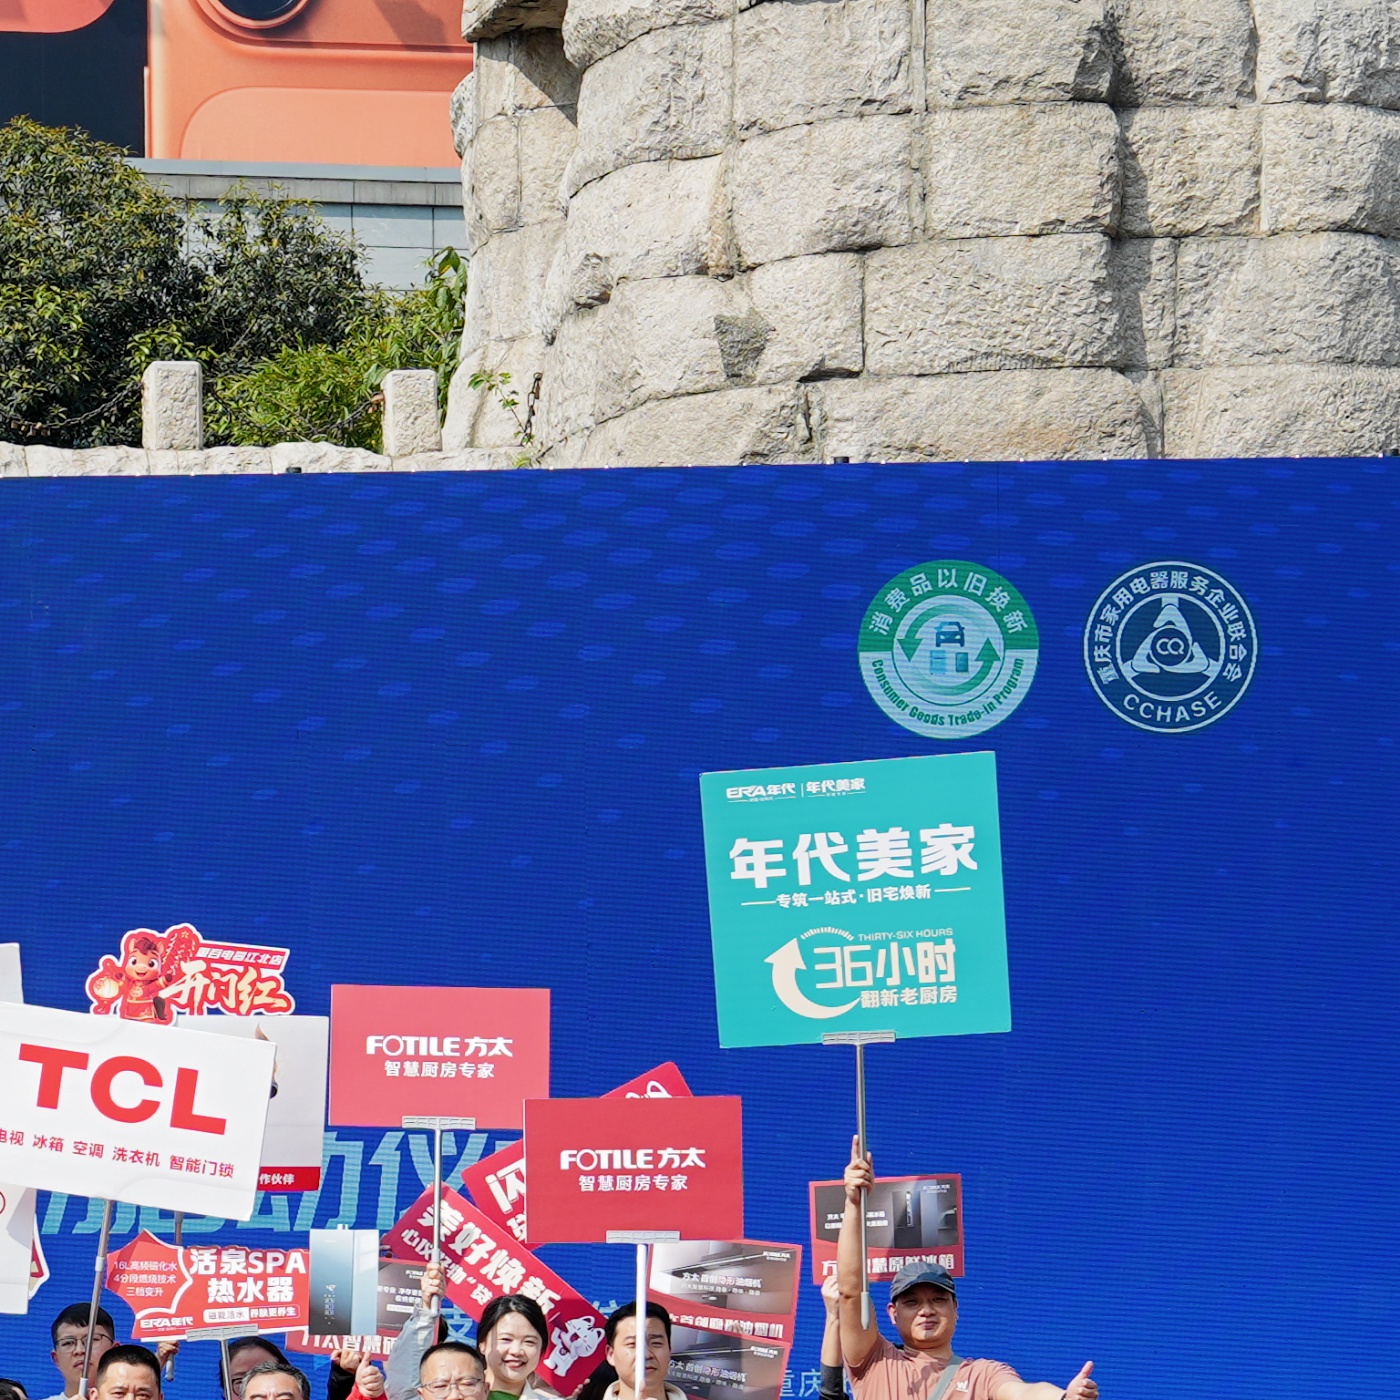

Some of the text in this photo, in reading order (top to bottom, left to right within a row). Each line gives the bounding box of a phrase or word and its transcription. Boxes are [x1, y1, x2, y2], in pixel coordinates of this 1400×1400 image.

[869, 568, 1029, 635] 消费品以旧换新
[1094, 569, 1246, 685] 重庆市家用电器服务企业联合会
[871, 658, 910, 711] Consumer
[908, 705, 946, 727] Goods
[993, 657, 1025, 706] Program
[1123, 691, 1223, 724] CCHASE
[726, 777, 866, 800] ERA年代 年代美家
[729, 823, 977, 889] 年代美家
[857, 927, 953, 941] THIRTY-SIX HOURS
[813, 938, 956, 990] 36小时
[161, 961, 289, 1016] 开门红
[859, 985, 958, 1009] 翻新老厨房
[366, 1034, 514, 1058] FOTILE 方太
[384, 1060, 495, 1080] 智慧厨房专家
[18, 1043, 227, 1135] TCL
[32, 1134, 65, 1153] 冰箱
[72, 1140, 105, 1159] 空调
[112, 1146, 161, 1168] 洗衣机
[169, 1155, 235, 1178] 智能门锁
[560, 1146, 706, 1171] FOTILE 方太
[578, 1174, 689, 1193] 智慧厨房专家
[189, 1247, 307, 1275] 活泉SPA
[207, 1276, 295, 1304] 热水器
[139, 1315, 194, 1329] ERA年代
